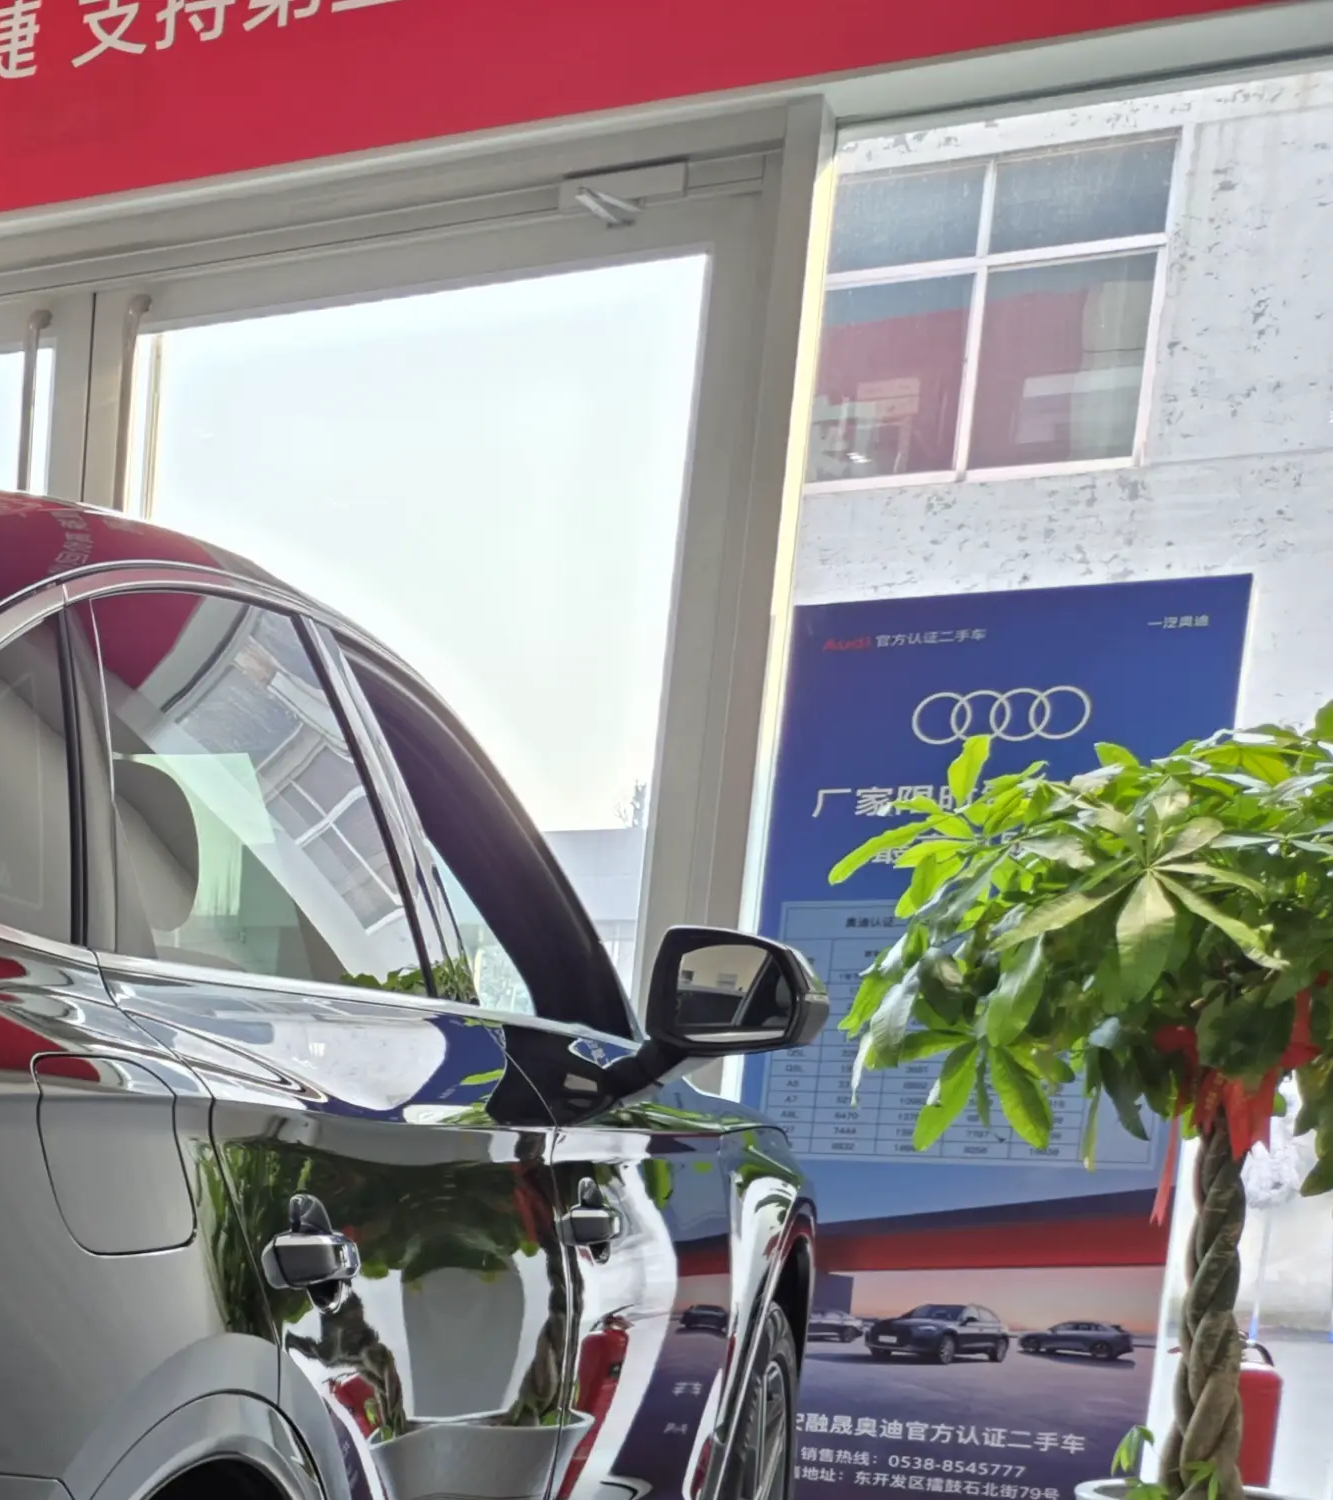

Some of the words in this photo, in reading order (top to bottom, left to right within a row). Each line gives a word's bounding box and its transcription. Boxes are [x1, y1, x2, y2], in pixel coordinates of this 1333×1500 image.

[71, 0, 401, 68] 支持
[875, 628, 987, 648] 官方认证二手车
